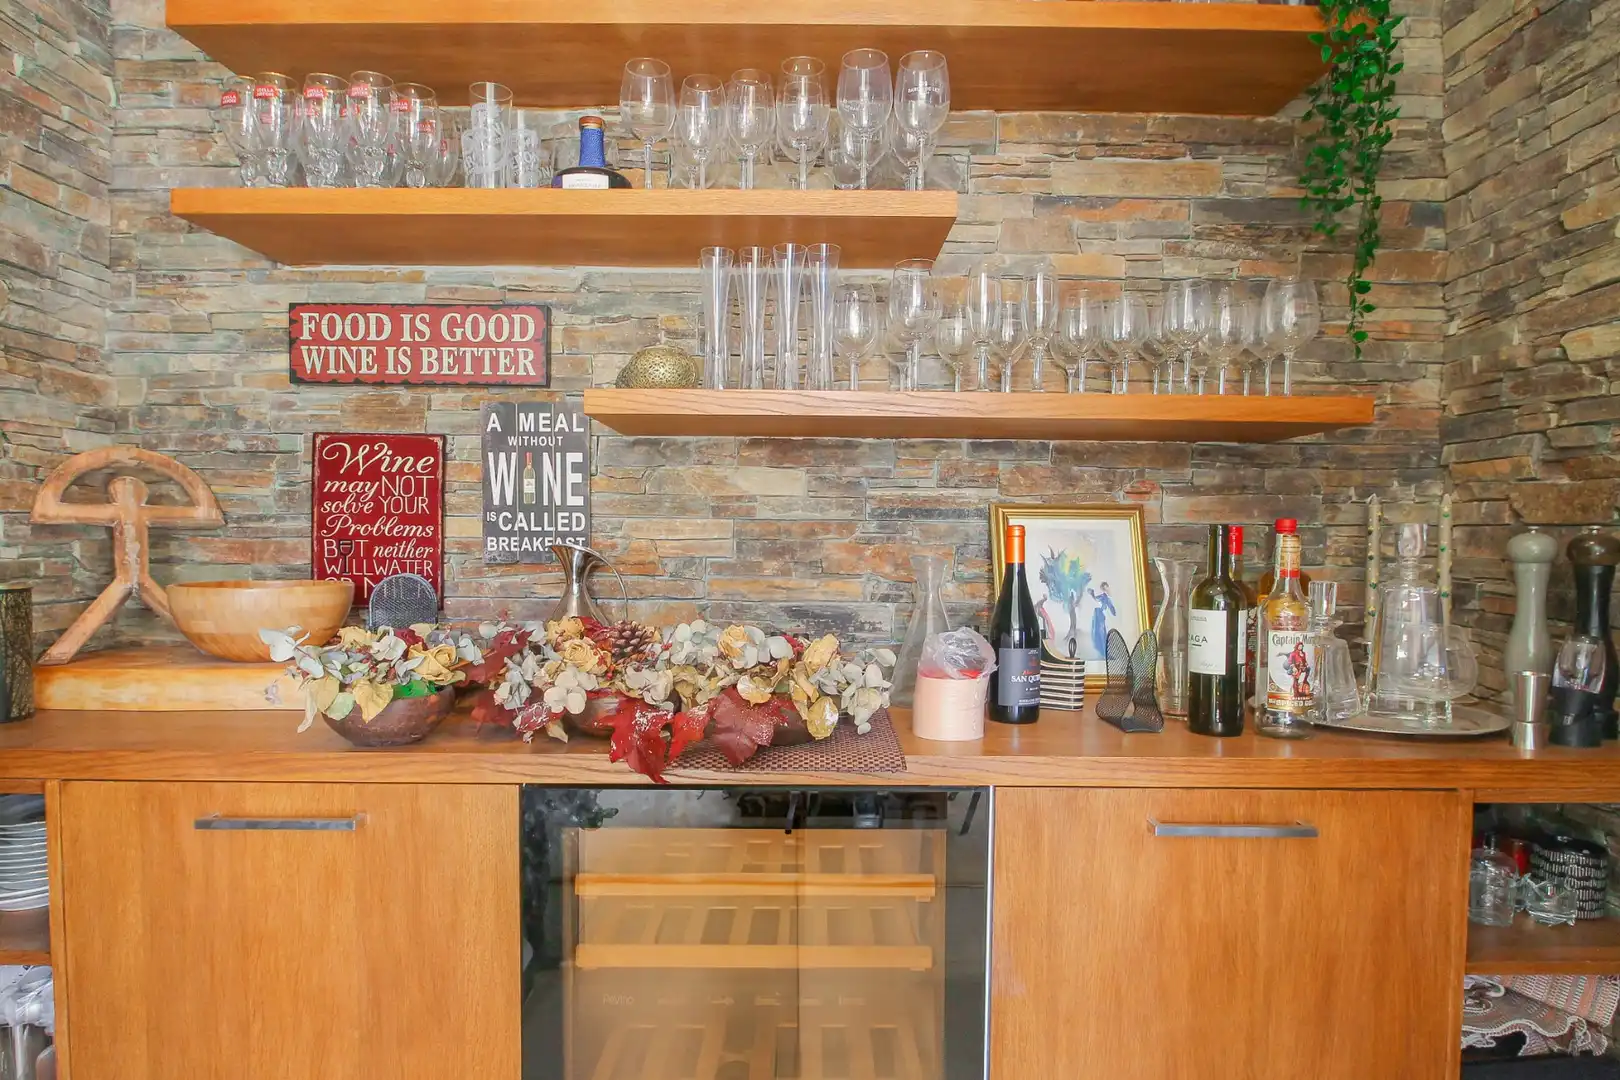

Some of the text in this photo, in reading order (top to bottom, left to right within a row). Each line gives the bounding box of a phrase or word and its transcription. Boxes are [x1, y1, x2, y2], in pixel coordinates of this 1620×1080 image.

[299, 312, 536, 342] FOOD IS GOOD
[300, 346, 536, 376] WINE IS BETTER
[486, 412, 585, 432] A MEAL
[507, 435, 563, 446] WITHOUT
[322, 442, 435, 476] Wine
[323, 475, 435, 502] may NOT
[321, 493, 430, 514] solve YOUR
[321, 513, 434, 537] Problems
[486, 511, 586, 532] IS CALLED
[373, 538, 433, 558] neither
[324, 558, 434, 577] WILL WATER
[1272, 633, 1300, 647] Captain
